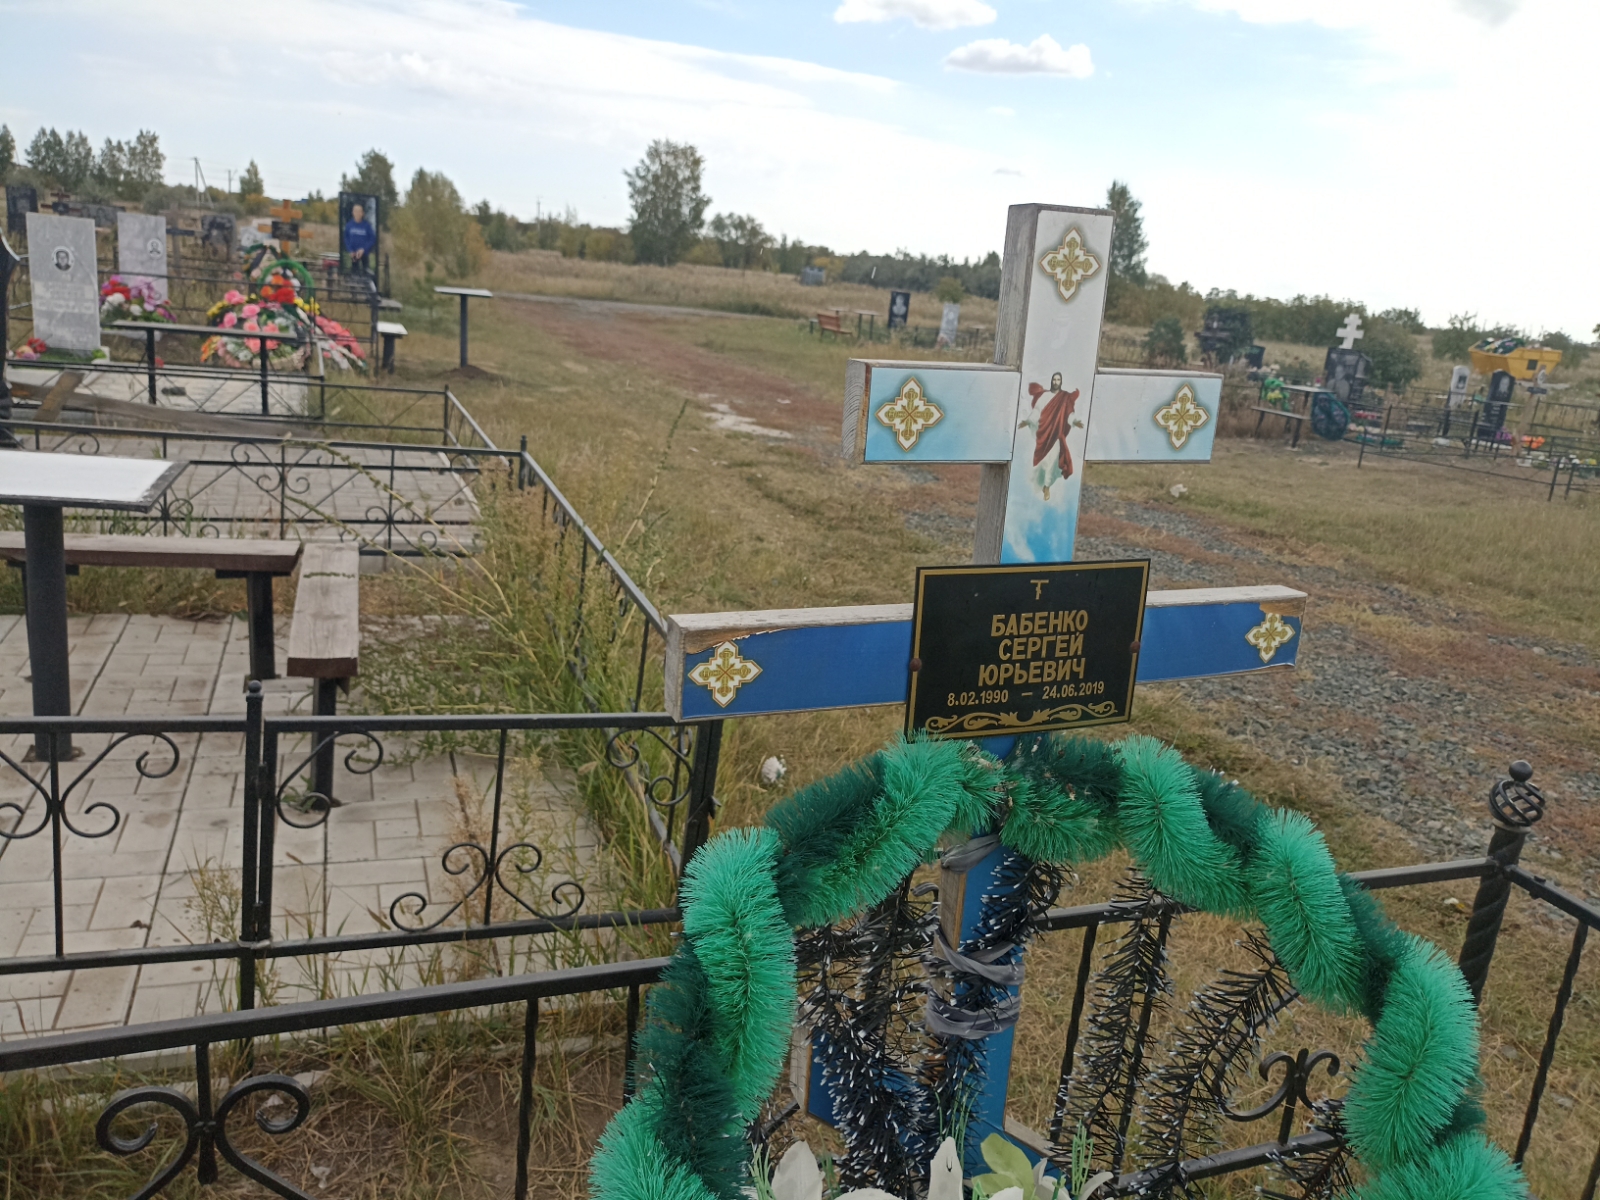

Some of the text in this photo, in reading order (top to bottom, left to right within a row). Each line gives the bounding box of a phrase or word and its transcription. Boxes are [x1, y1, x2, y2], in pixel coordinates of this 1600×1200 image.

[991, 610, 1088, 637] БАБЕНКО
[999, 632, 1084, 660] СЕРГЕЙ
[978, 658, 1086, 687] ЮРЬЕВИЧ
[947, 690, 1009, 706] 8.02.1990
[1042, 681, 1104, 700] 24.06.2019
